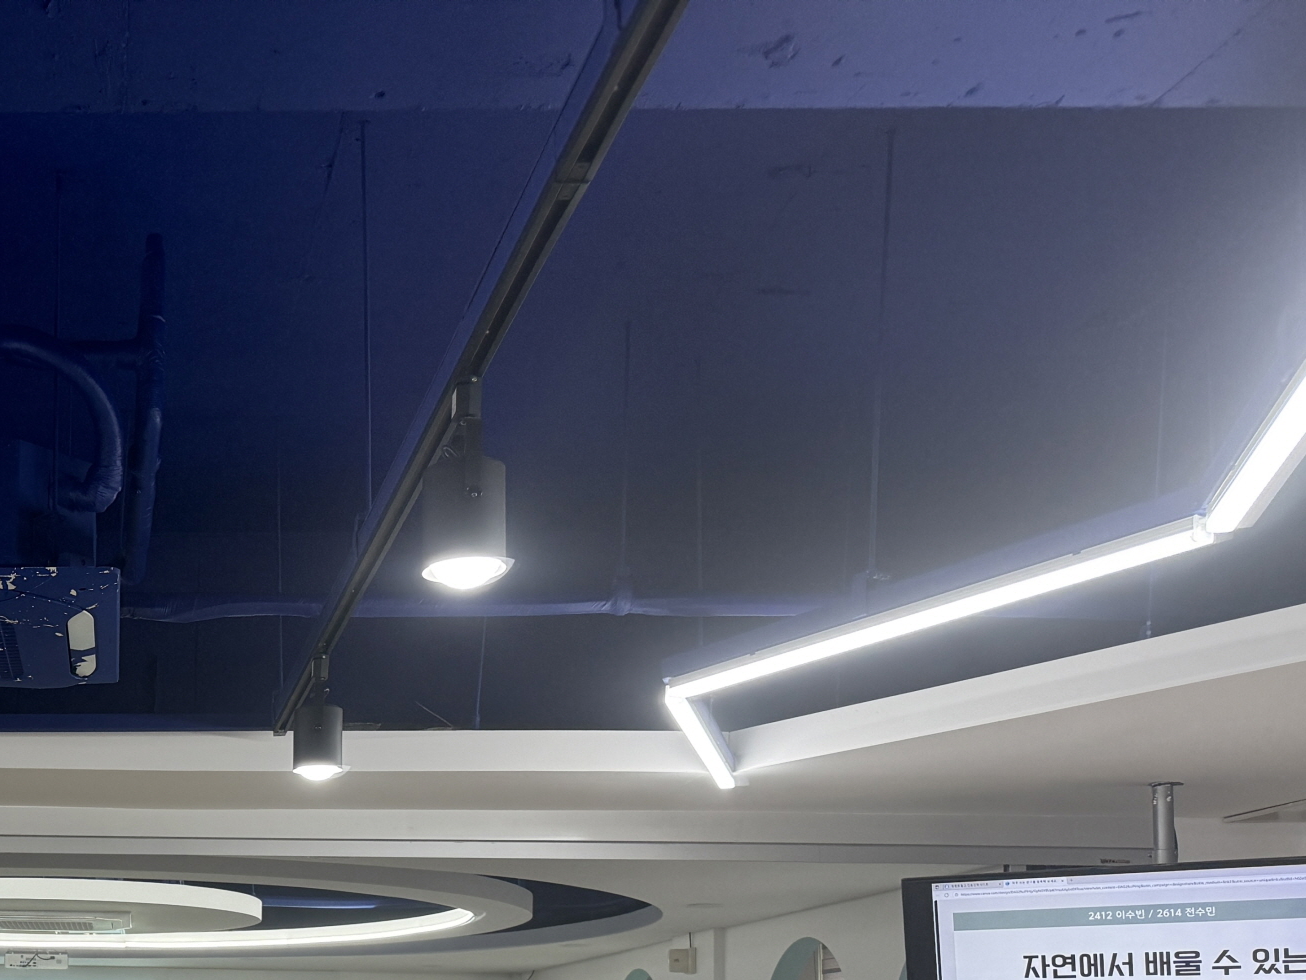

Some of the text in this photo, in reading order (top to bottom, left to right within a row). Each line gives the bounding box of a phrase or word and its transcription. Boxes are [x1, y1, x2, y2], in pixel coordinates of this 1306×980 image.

[1088, 911, 1113, 921] 2412
[1116, 909, 1145, 920] 이수빈
[1156, 908, 1182, 918] 2614
[1185, 906, 1216, 918] 전수민
[1022, 947, 1306, 979] 자연에서 배울 수 있는
